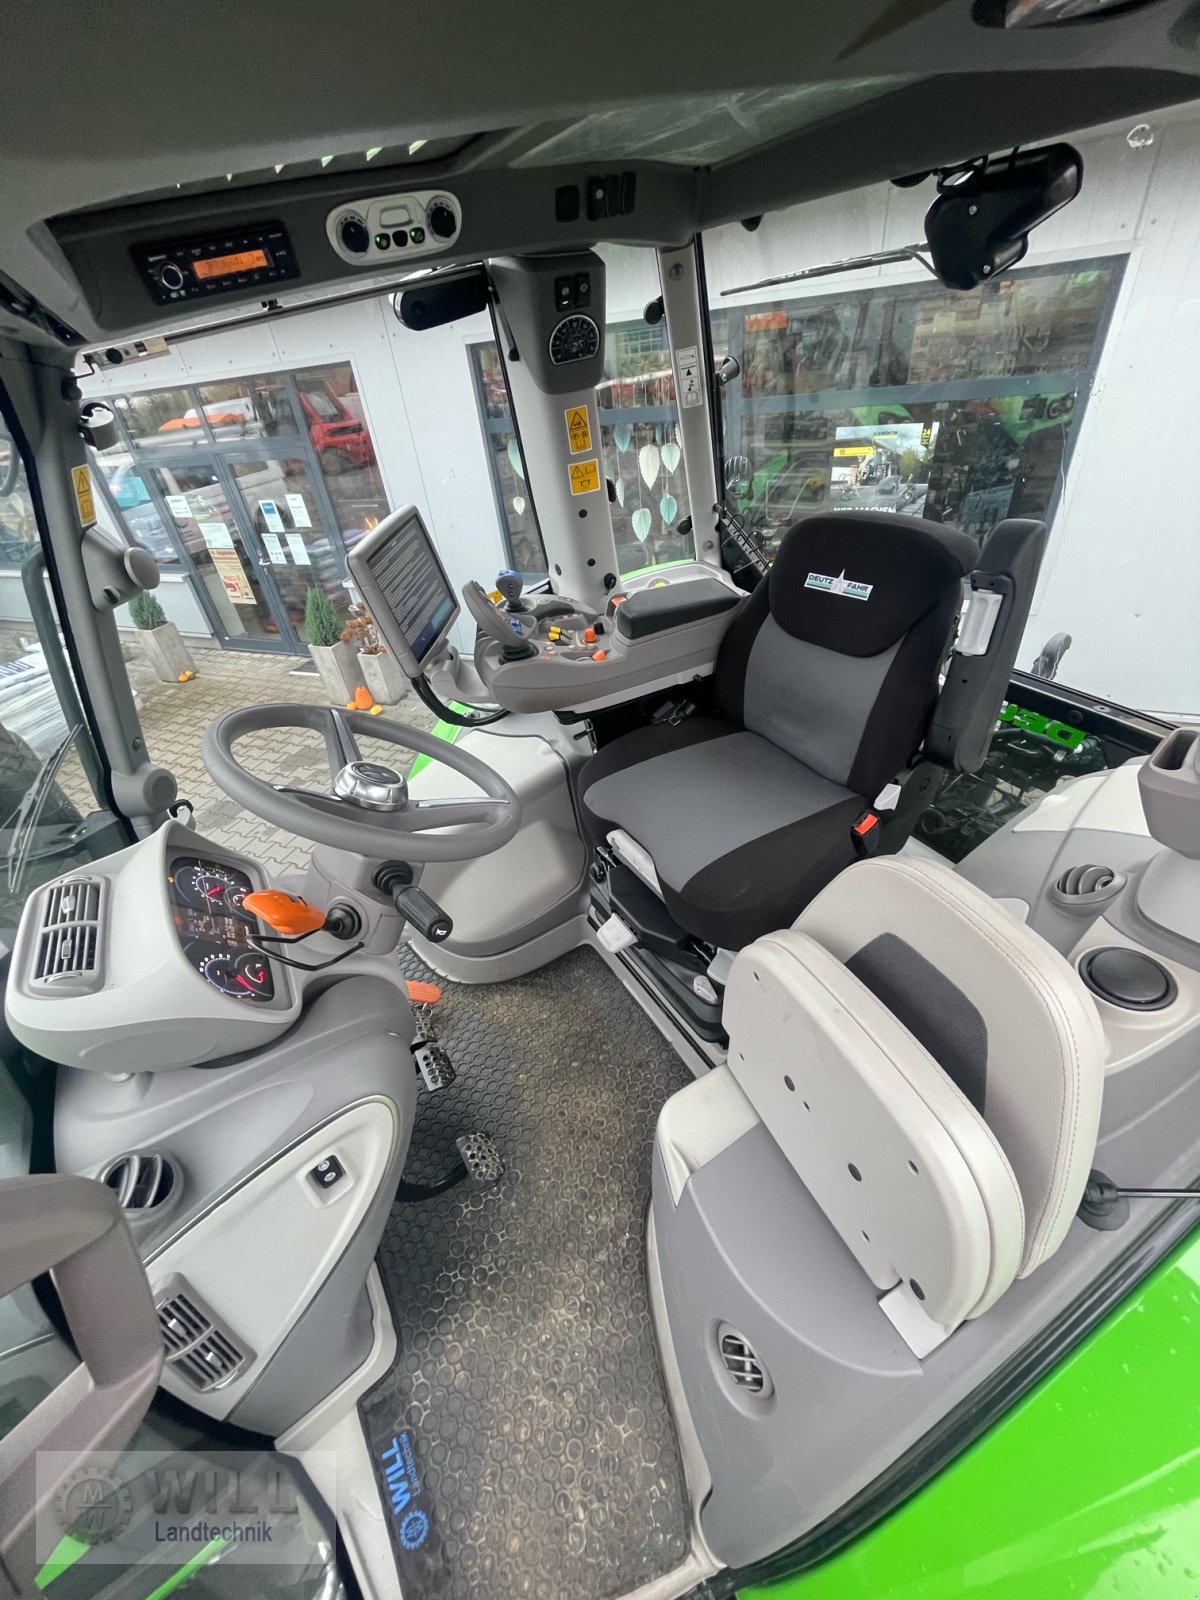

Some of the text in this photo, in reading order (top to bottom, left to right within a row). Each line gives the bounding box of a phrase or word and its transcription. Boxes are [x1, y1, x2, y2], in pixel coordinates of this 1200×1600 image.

[808, 574, 869, 592] DEUTZ FAHR
[382, 1437, 412, 1515] WILL
[399, 1431, 422, 1497] Landtechnik
